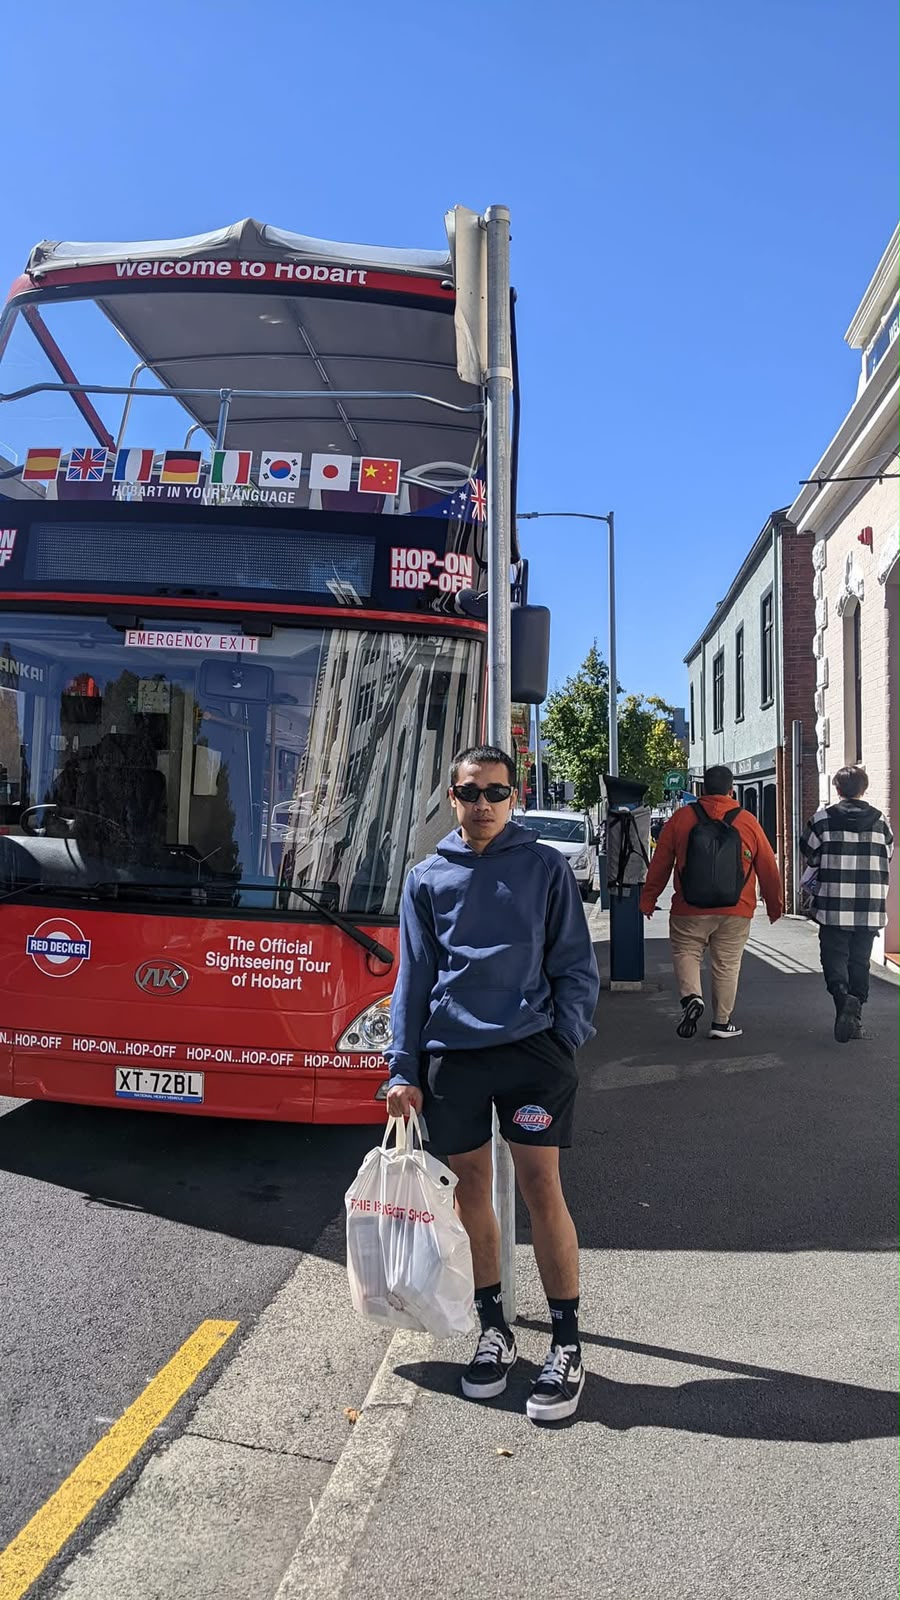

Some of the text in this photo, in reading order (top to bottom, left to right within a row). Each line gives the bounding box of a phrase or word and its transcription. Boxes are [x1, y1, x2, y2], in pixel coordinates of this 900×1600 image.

[115, 260, 368, 285] Welcome to Hobart
[112, 485, 296, 504] HOBART IN YOUR LANGUAGE
[391, 547, 473, 577] HOP-ON
[391, 569, 473, 593] HOP-OFF
[128, 631, 257, 651] EMERGENCY EXIT
[30, 939, 87, 955] RED DECKER
[227, 935, 313, 955] The Official
[205, 951, 331, 975] Sightseeing Tour
[231, 972, 303, 990] of Hobart
[72, 1038, 177, 1058] HOP-ON...HOP-OFF
[186, 1047, 295, 1066] HOP-ON...HOP-OFF
[516, 1113, 549, 1124] FIREFLY
[351, 1198, 371, 1211] THE
